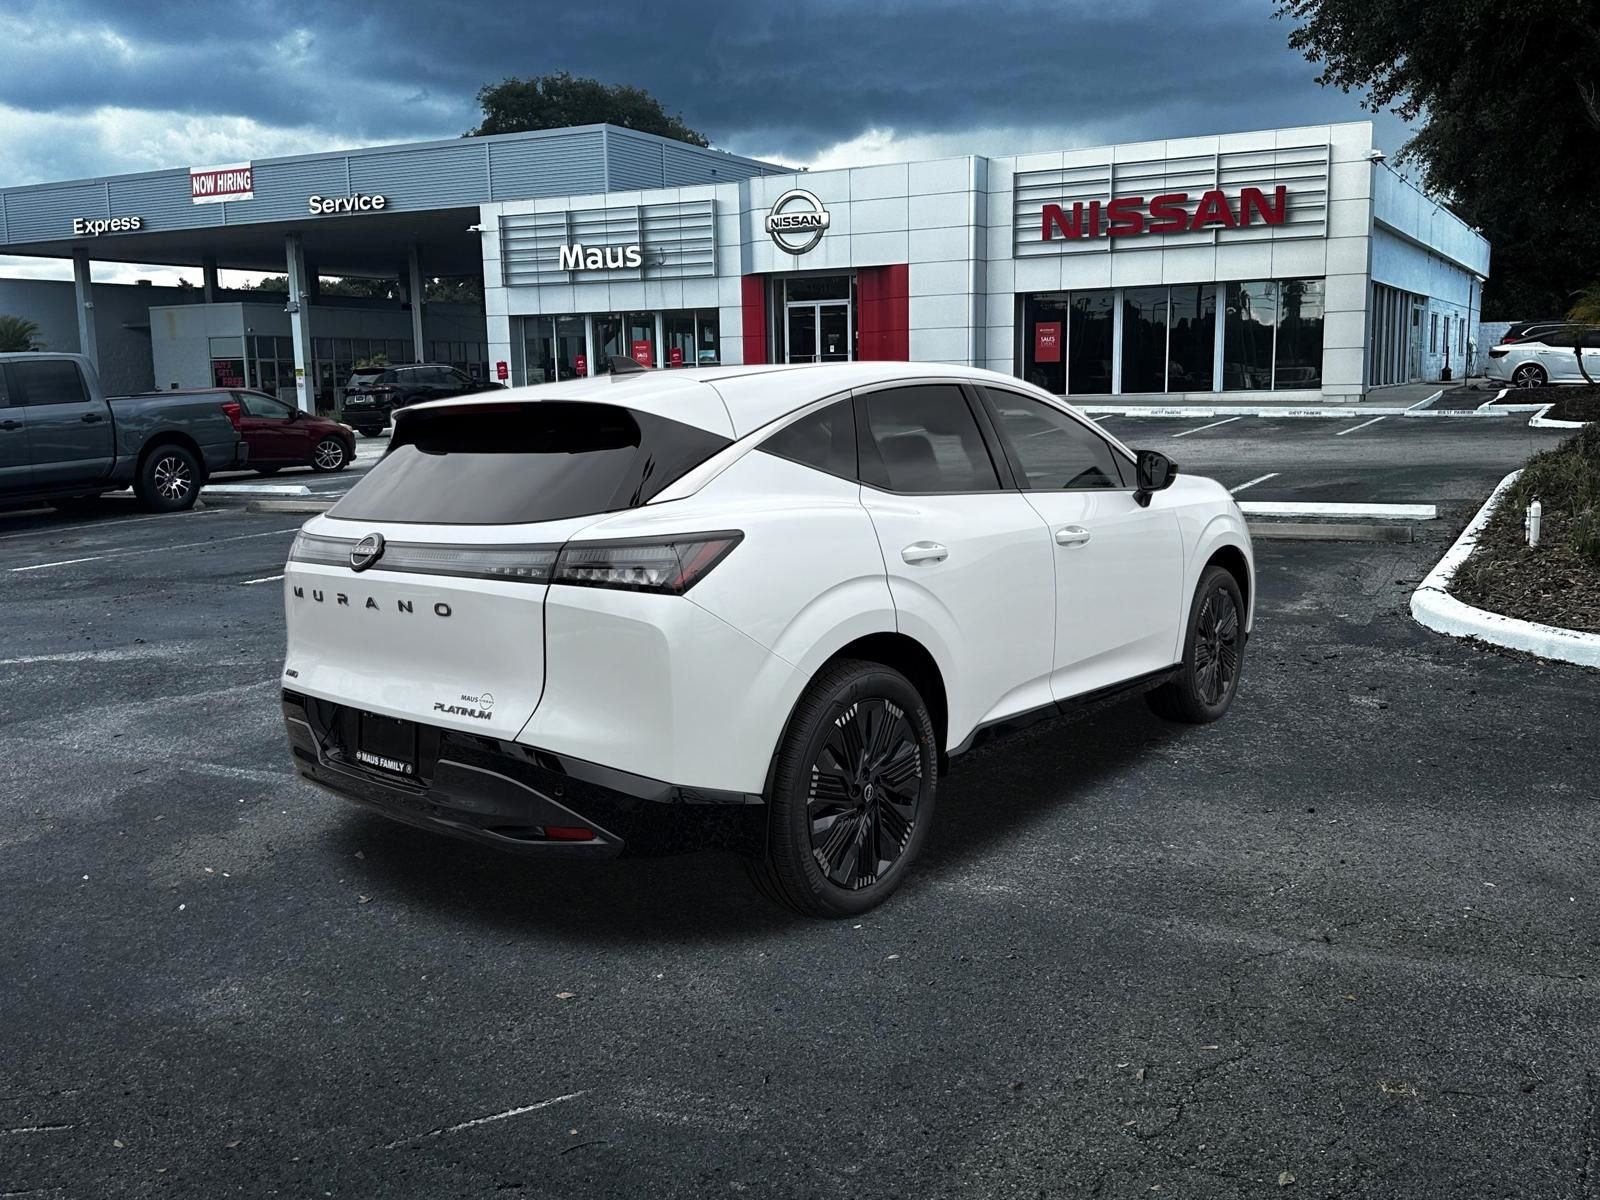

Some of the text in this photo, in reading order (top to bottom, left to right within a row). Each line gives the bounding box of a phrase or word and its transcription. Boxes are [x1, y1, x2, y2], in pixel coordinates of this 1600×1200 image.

[192, 171, 251, 195] NOW HIRING
[308, 193, 385, 215] Service
[1041, 185, 1287, 241] NISSAN
[73, 215, 141, 236] Express
[770, 215, 822, 228] NISSAN
[559, 243, 642, 271] Maus
[223, 377, 244, 386] FREE
[293, 586, 452, 617] MURANO
[461, 694, 479, 703] MAUS
[433, 702, 493, 721] PLATINUM
[361, 752, 405, 772] MAUS FAMILY
